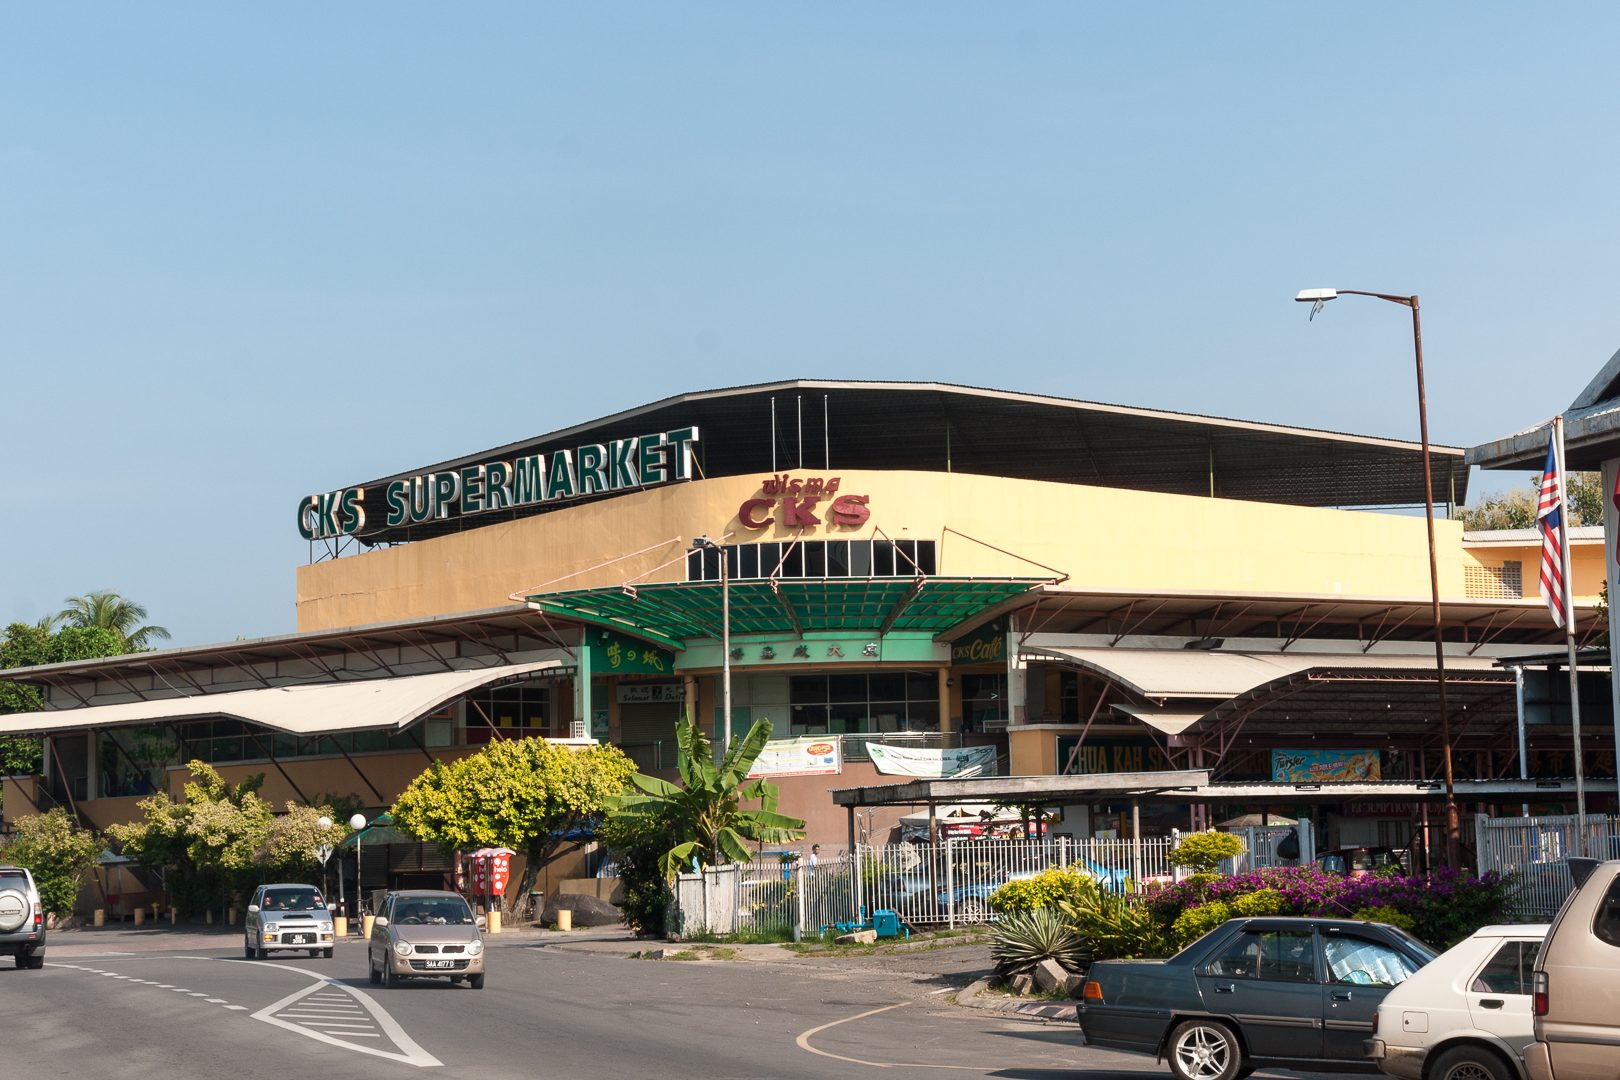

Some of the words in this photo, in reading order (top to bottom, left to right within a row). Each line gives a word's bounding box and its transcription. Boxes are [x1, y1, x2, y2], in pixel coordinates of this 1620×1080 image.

[298, 487, 365, 539] CKS
[386, 426, 698, 526] SUPERMARKET
[739, 495, 870, 528] CKS
[1068, 746, 1107, 774] CHUA
[1113, 746, 1144, 772] KAH
